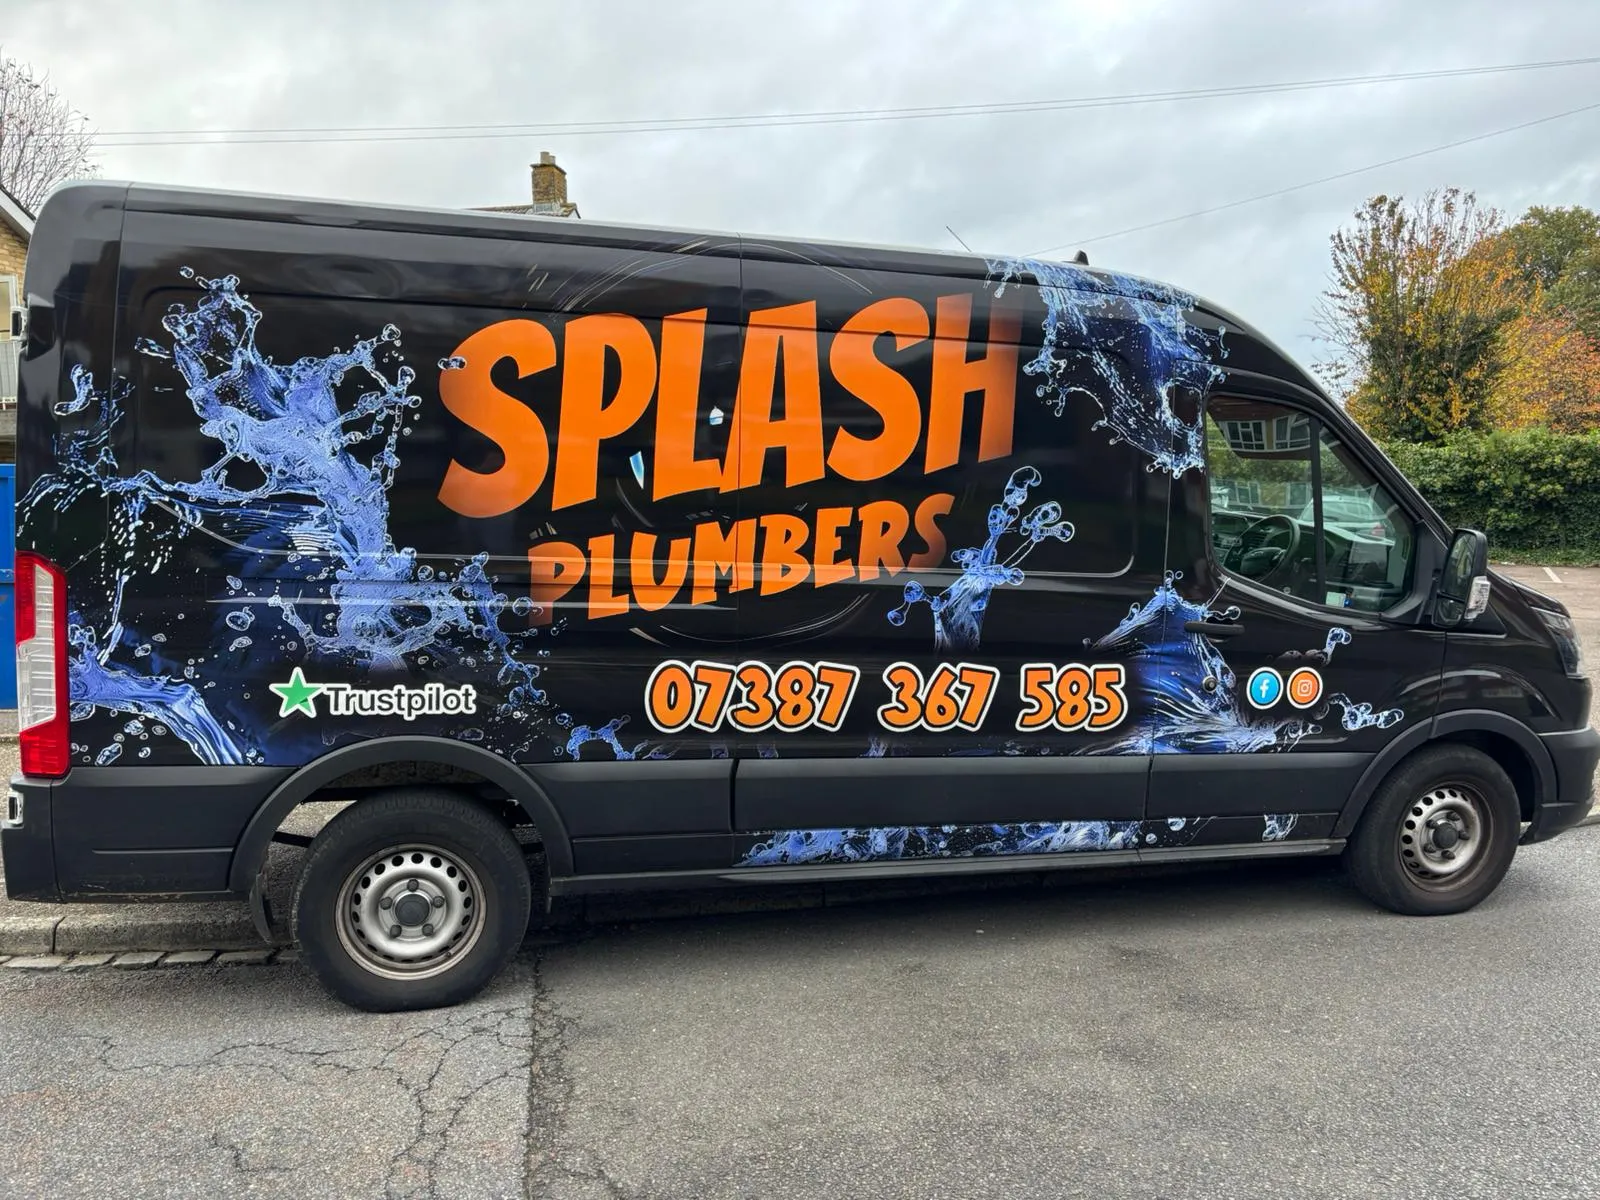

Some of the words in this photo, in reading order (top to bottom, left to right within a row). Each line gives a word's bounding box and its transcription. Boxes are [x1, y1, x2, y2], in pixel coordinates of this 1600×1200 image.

[437, 293, 1023, 519] SPLASH
[527, 493, 956, 628] PLUMBERS
[325, 685, 475, 718] Trustpilot
[648, 662, 858, 730] 07387
[880, 663, 997, 730] 367
[1018, 664, 1126, 730] 585
